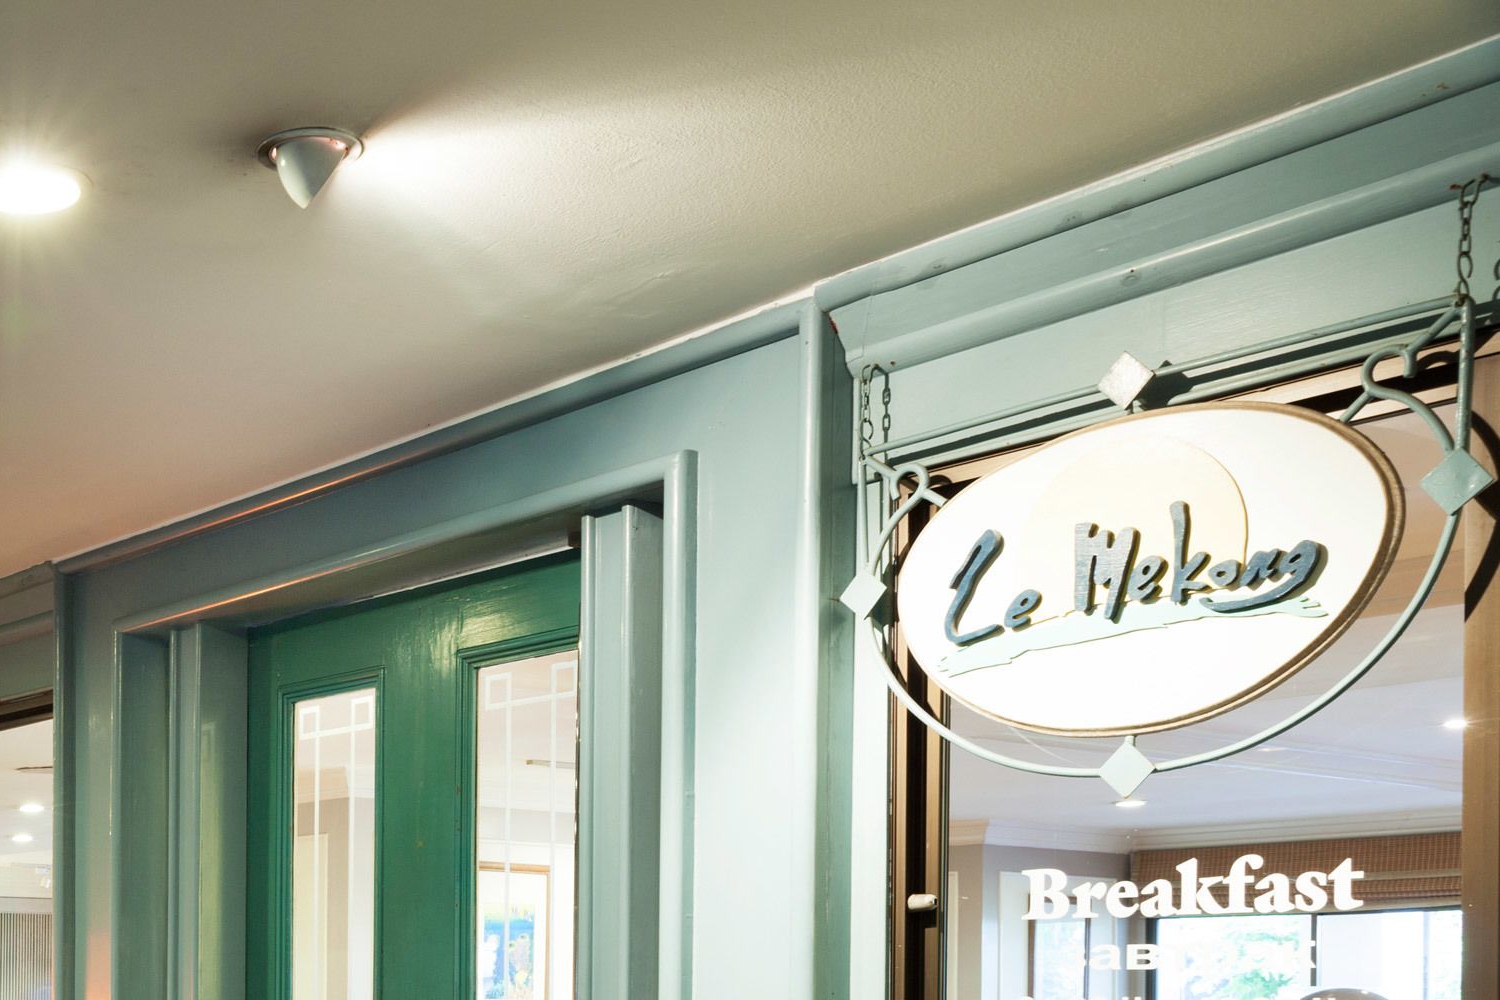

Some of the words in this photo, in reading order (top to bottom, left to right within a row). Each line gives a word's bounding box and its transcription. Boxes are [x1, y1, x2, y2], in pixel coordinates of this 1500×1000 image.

[945, 528, 1043, 646] Le
[1074, 500, 1328, 622] Mekong
[1021, 853, 1366, 920] Breakfast
